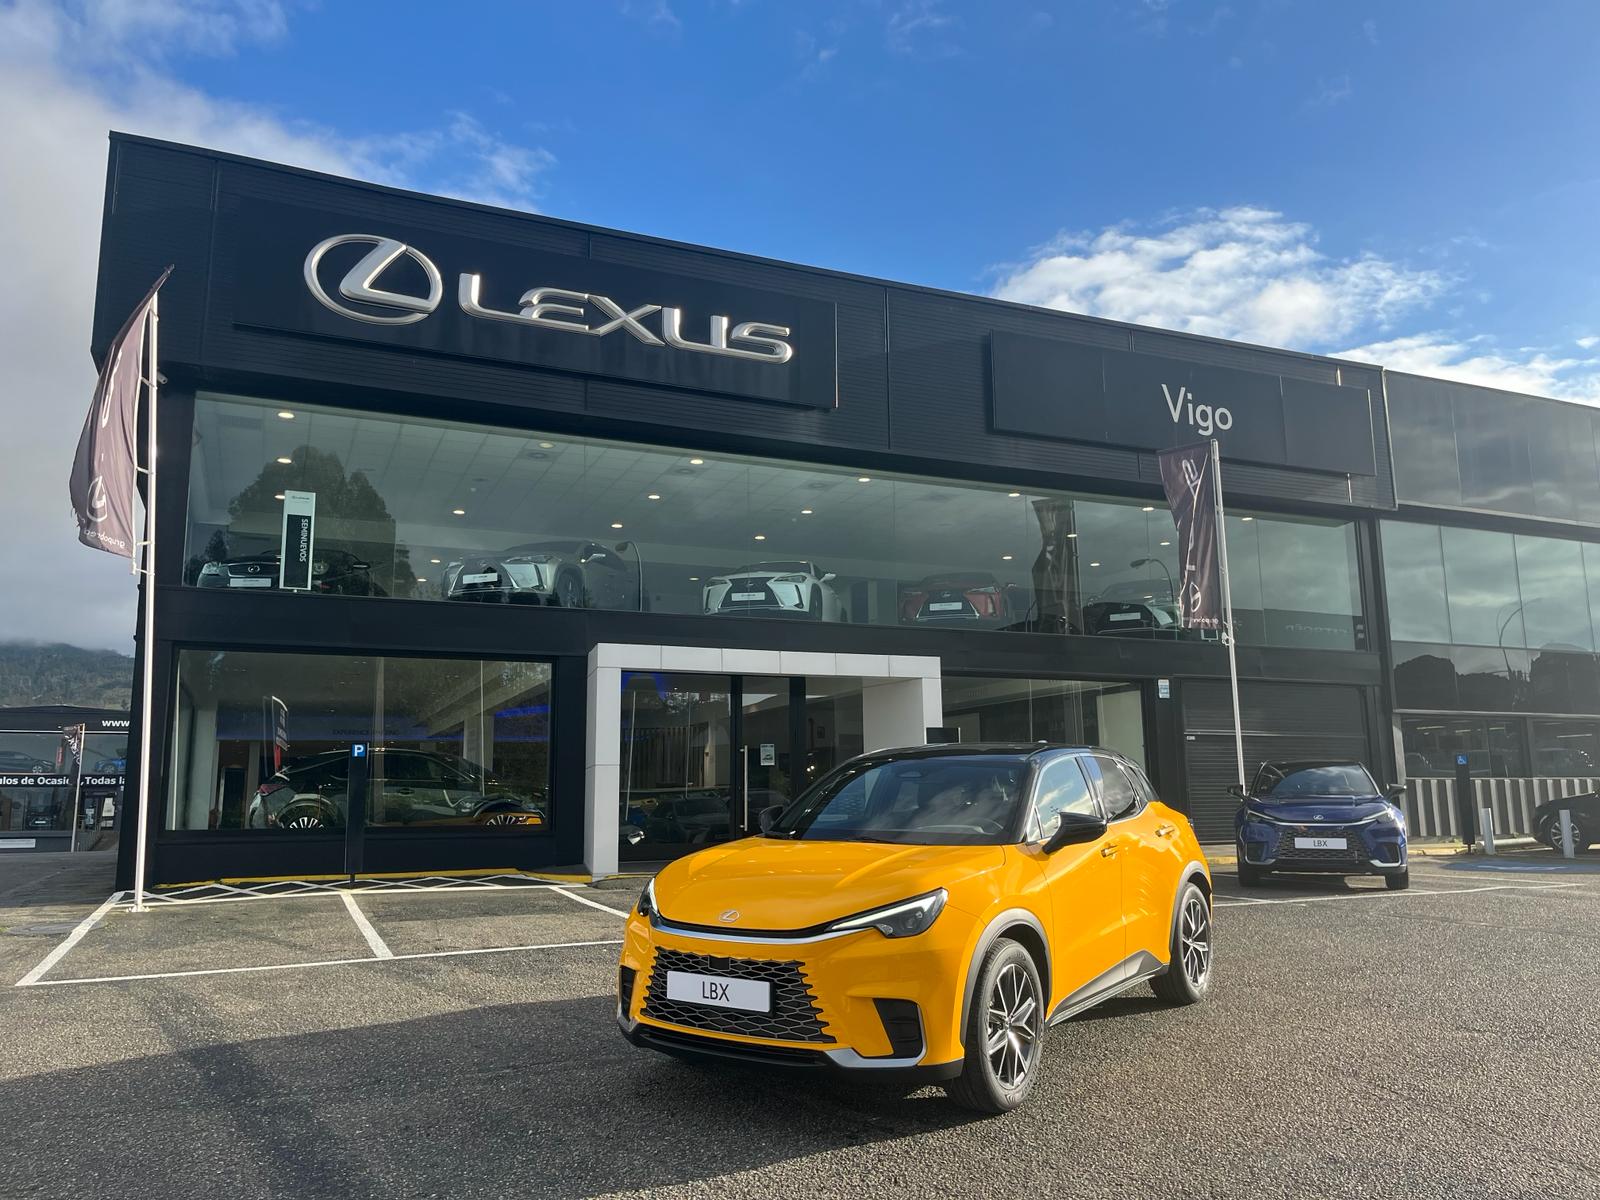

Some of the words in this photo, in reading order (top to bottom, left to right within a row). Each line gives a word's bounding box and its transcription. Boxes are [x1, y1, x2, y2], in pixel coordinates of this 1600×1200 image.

[459, 273, 793, 364] LEXUS
[1161, 383, 1233, 436] Vigo
[300, 518, 309, 563] SEMINUEVOS
[354, 745, 365, 757] P
[21, 776, 35, 785] de
[1313, 840, 1328, 848] LBX
[702, 981, 730, 1002] LBX
